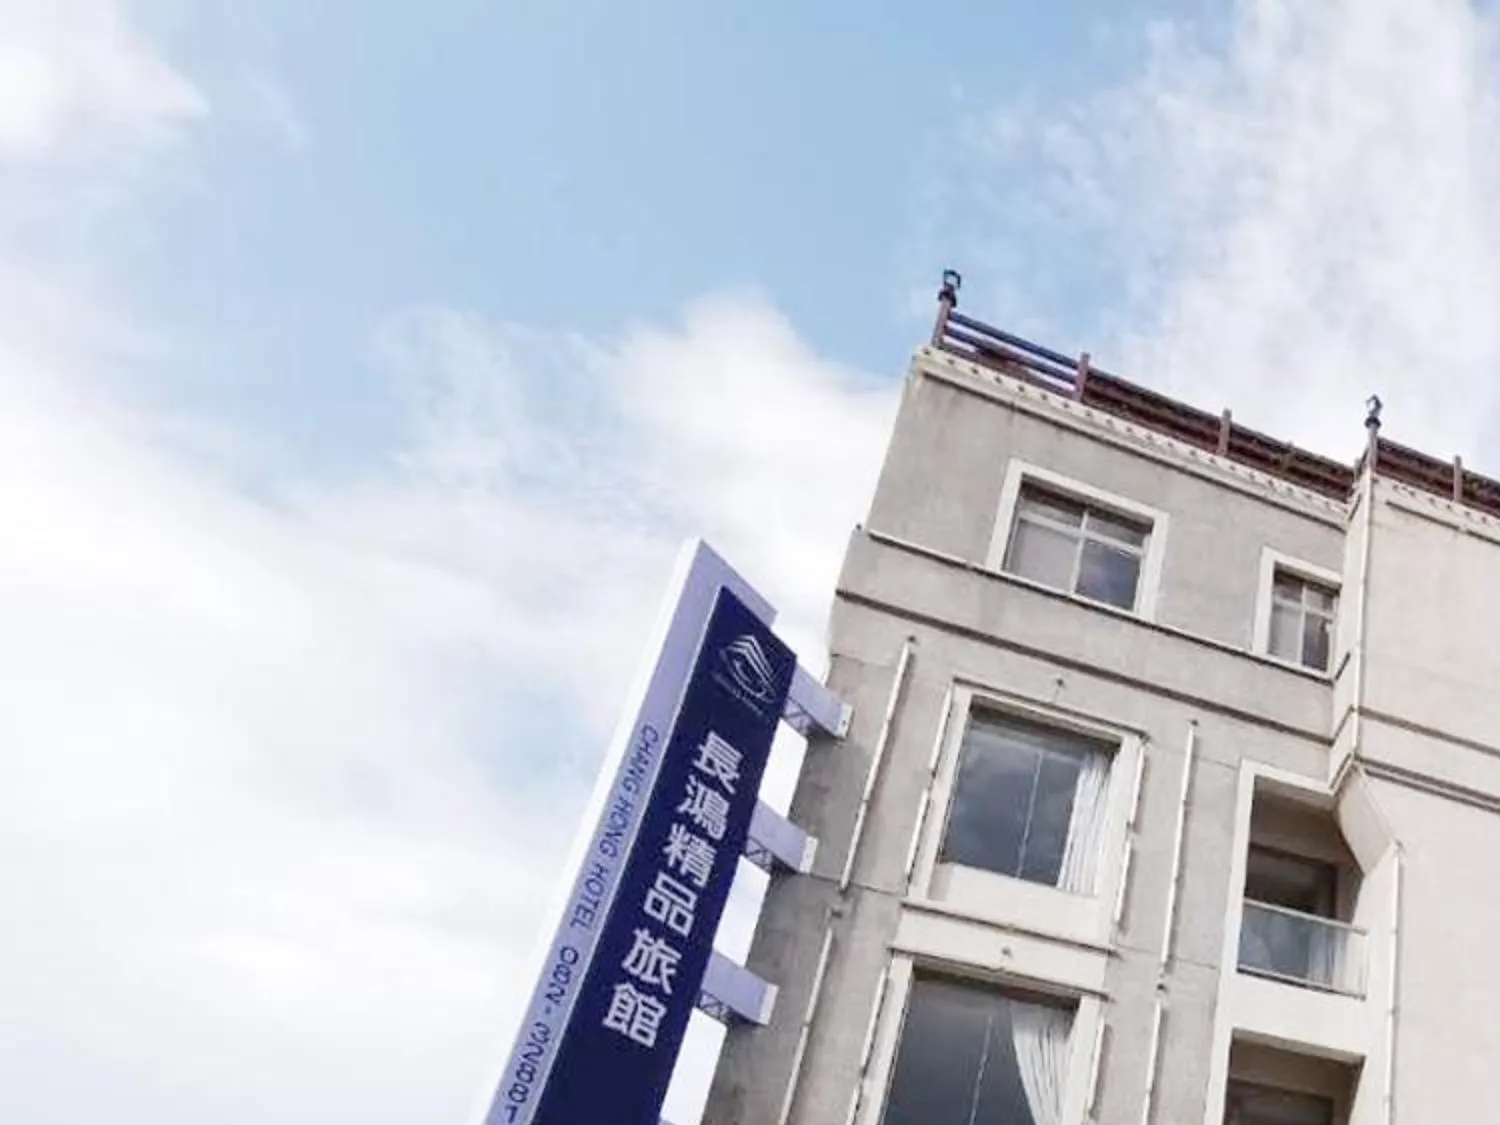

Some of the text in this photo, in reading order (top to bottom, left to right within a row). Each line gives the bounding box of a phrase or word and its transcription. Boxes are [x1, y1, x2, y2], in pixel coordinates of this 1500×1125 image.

[621, 724, 659, 795] CHANG
[600, 796, 634, 858] HONG
[570, 863, 609, 929] HOTEL
[602, 730, 743, 1048] 長鴻精品旅館
